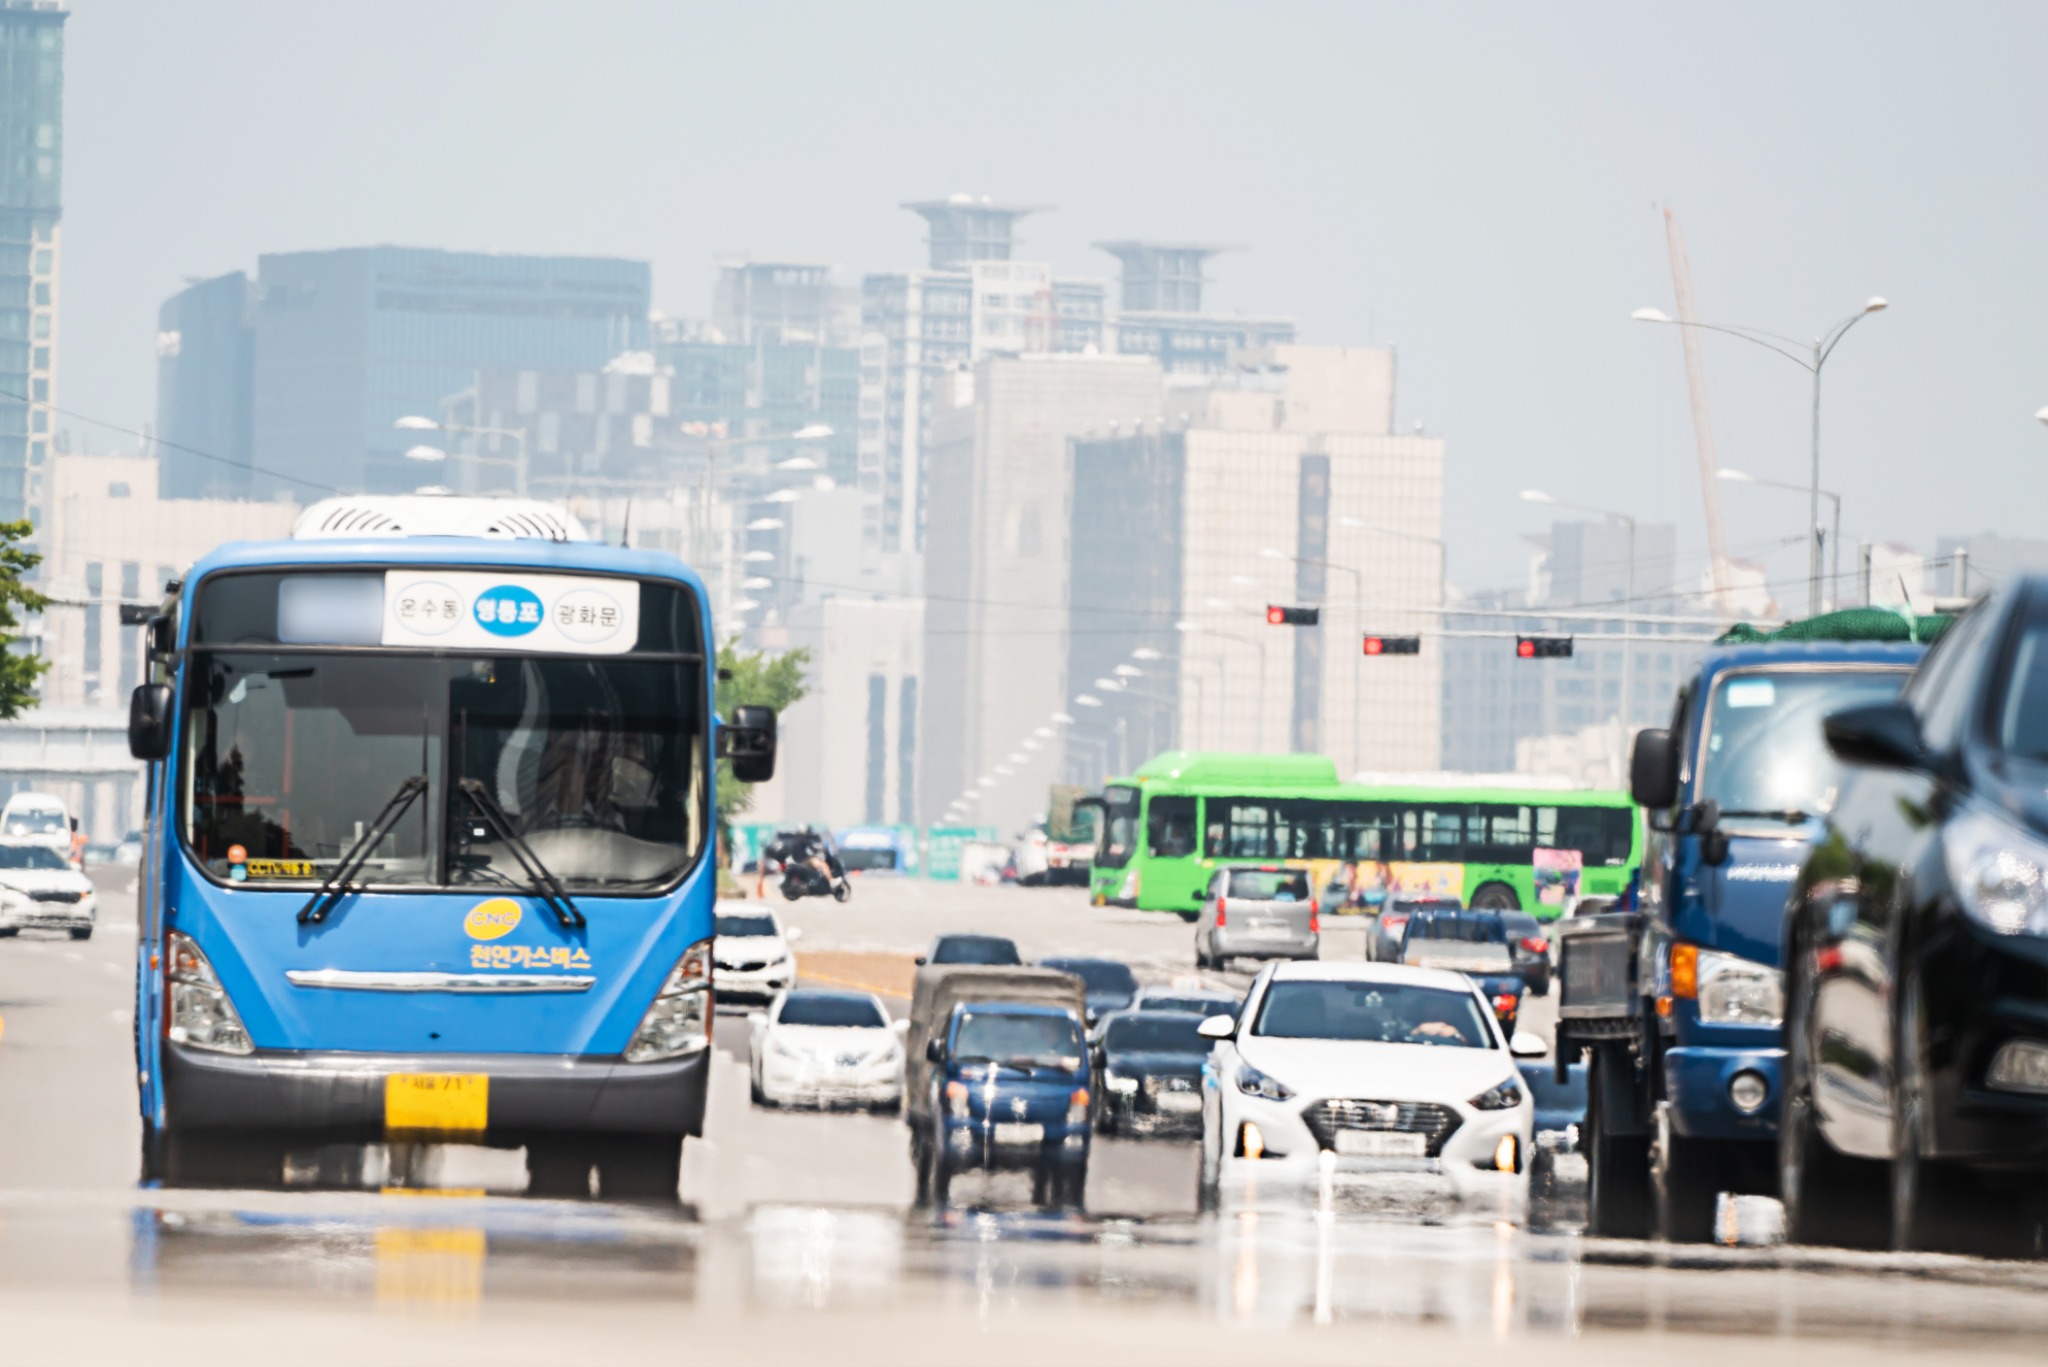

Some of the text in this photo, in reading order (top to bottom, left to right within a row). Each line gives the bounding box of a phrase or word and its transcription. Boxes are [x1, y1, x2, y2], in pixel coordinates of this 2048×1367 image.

[401, 598, 617, 628] 온수동 영등포 광화문
[471, 912, 516, 926] CNG
[470, 944, 592, 969] 천연가스버스
